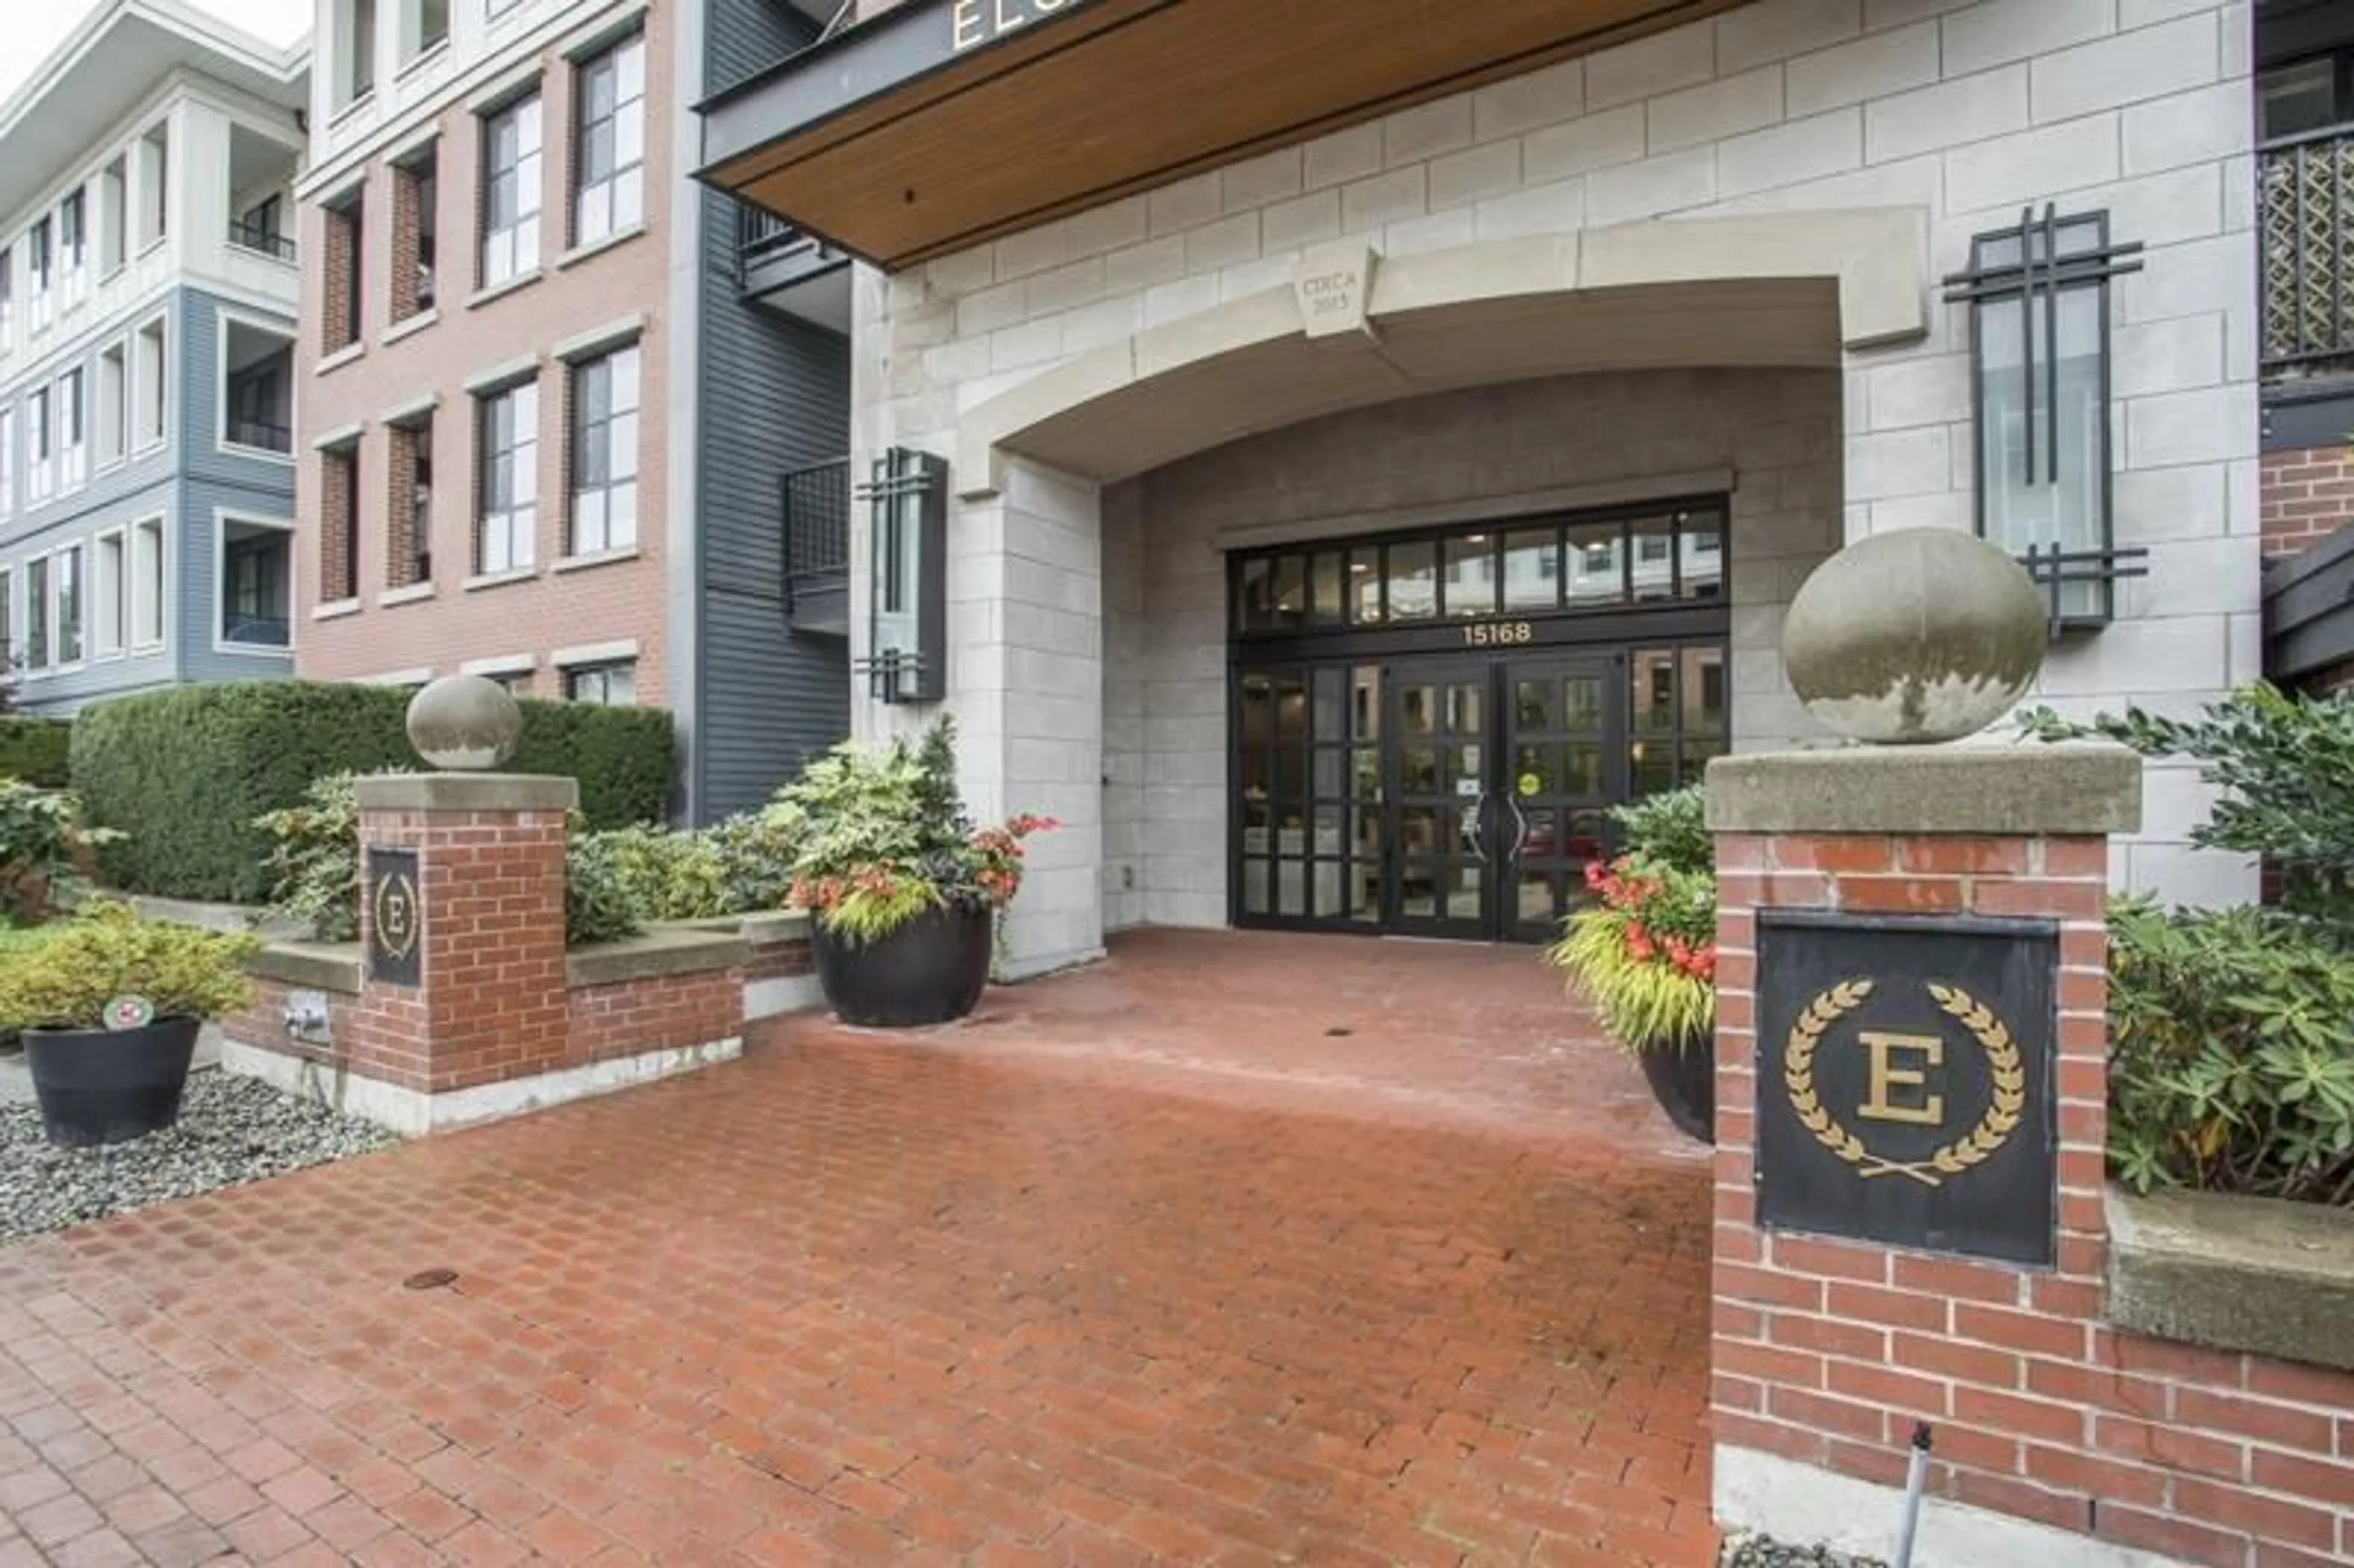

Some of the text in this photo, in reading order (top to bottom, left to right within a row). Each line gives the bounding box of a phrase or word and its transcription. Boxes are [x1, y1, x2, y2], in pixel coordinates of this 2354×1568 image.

[953, 0, 1065, 48] EL
[1304, 271, 1357, 297] CIRCA
[1463, 622, 1531, 645] 15168
[387, 896, 405, 934] E
[1858, 1032, 1943, 1125] E
